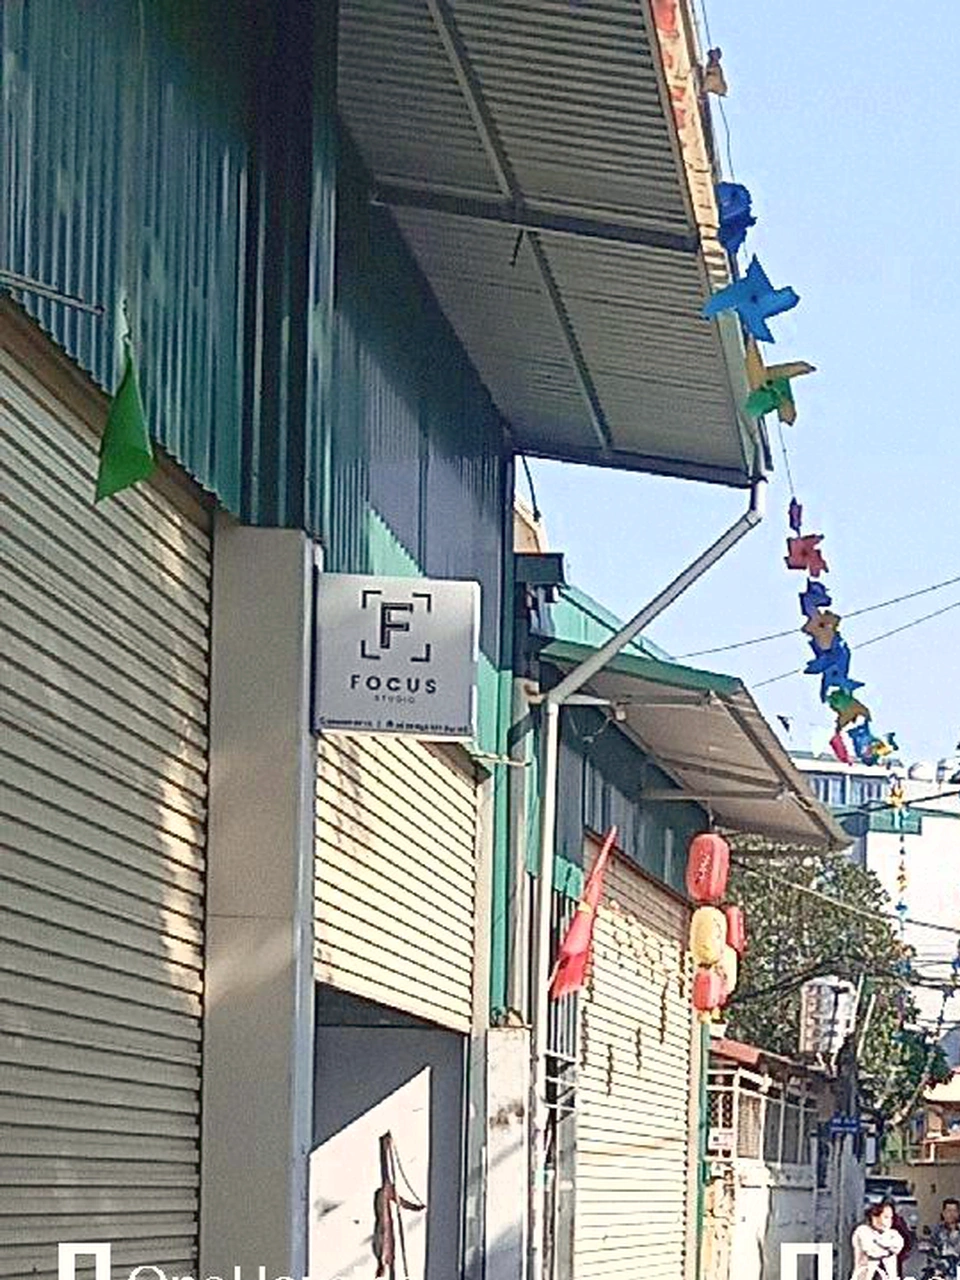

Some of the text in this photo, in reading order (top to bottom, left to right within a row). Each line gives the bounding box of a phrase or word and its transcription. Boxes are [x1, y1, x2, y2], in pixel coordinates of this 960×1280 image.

[380, 602, 413, 649] F
[350, 674, 437, 694] FOCUS
[374, 694, 416, 704] STUDIO
